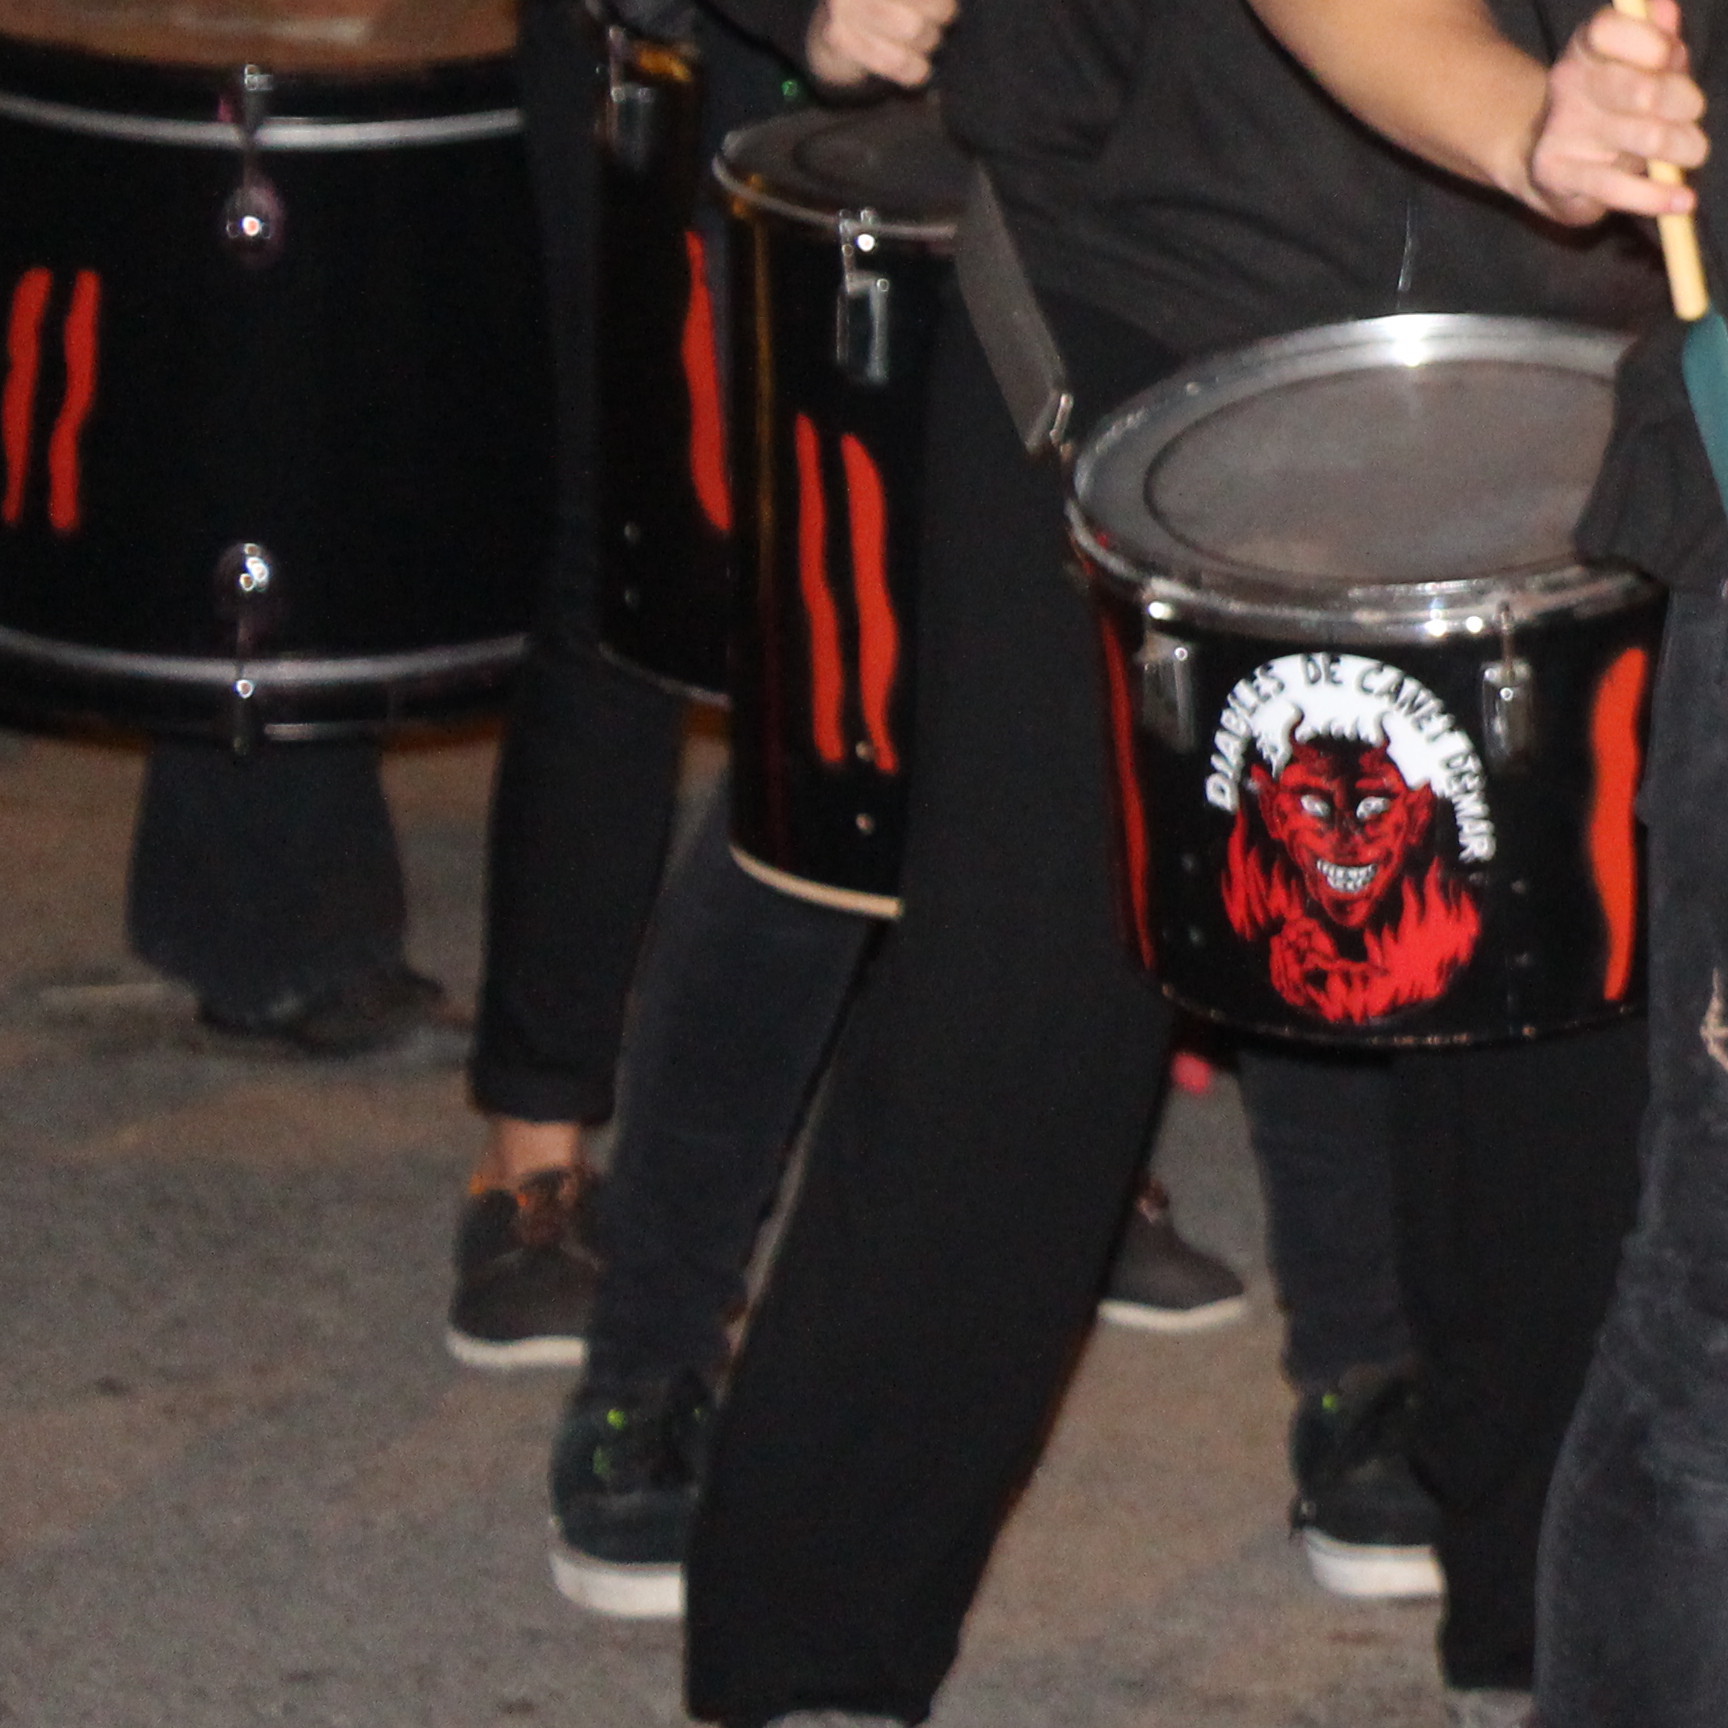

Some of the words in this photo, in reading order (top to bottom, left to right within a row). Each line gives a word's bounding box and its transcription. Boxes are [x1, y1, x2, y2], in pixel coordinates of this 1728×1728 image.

[1206, 662, 1286, 814] DIABLES
[1301, 651, 1343, 687] DE
[1355, 662, 1456, 742] CANET
